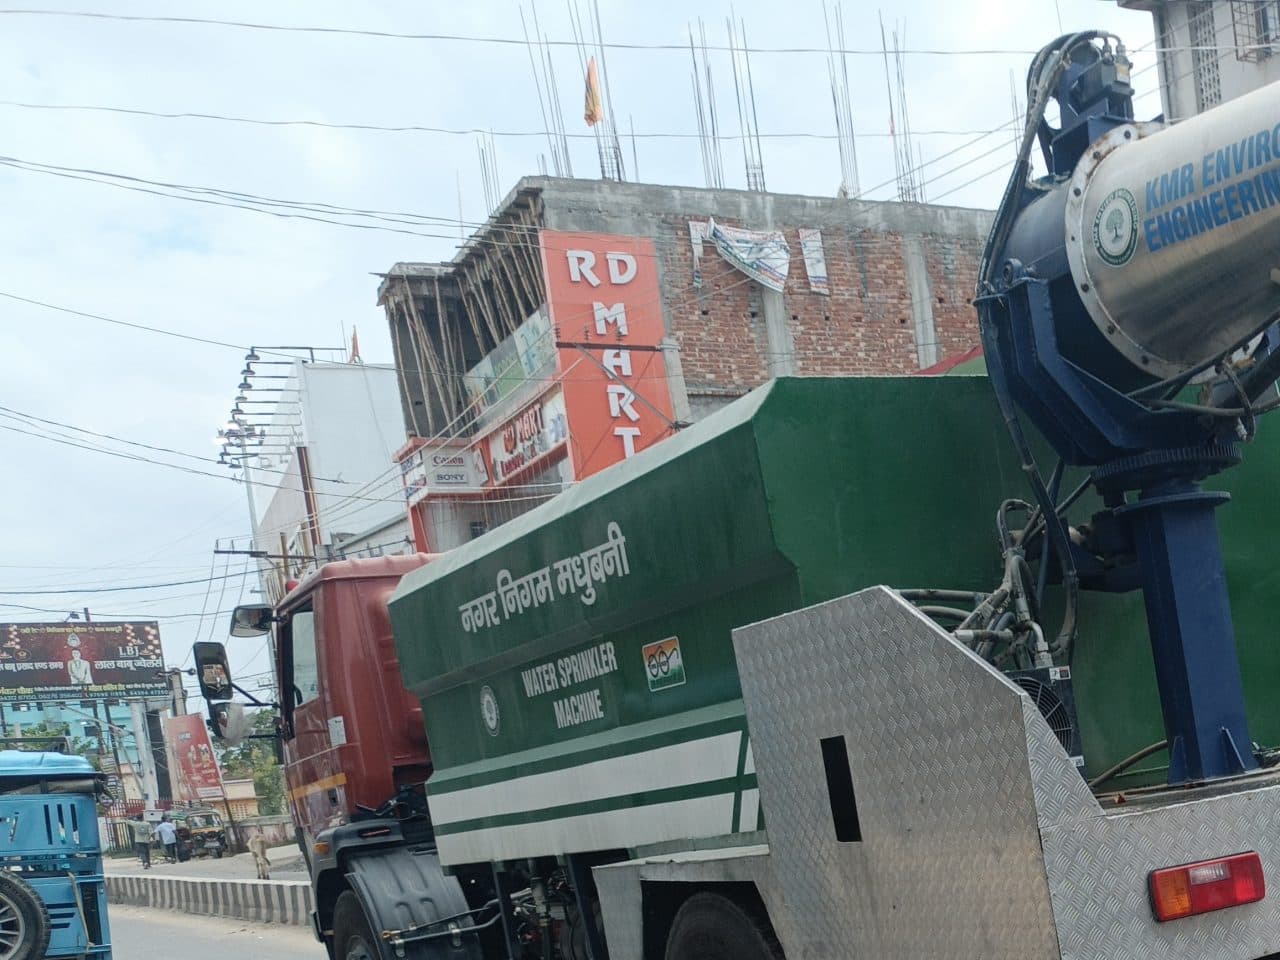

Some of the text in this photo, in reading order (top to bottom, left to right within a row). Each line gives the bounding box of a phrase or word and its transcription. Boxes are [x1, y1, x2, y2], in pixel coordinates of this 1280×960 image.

[1145, 163, 1195, 213] KMR
[566, 249, 638, 287] RD
[433, 455, 464, 465] Canon
[437, 473, 465, 481] SONY
[459, 521, 631, 633] नगर निगम मधुबनी
[521, 641, 618, 698] WATER SPRINKLER
[553, 688, 604, 729] MACHINE
